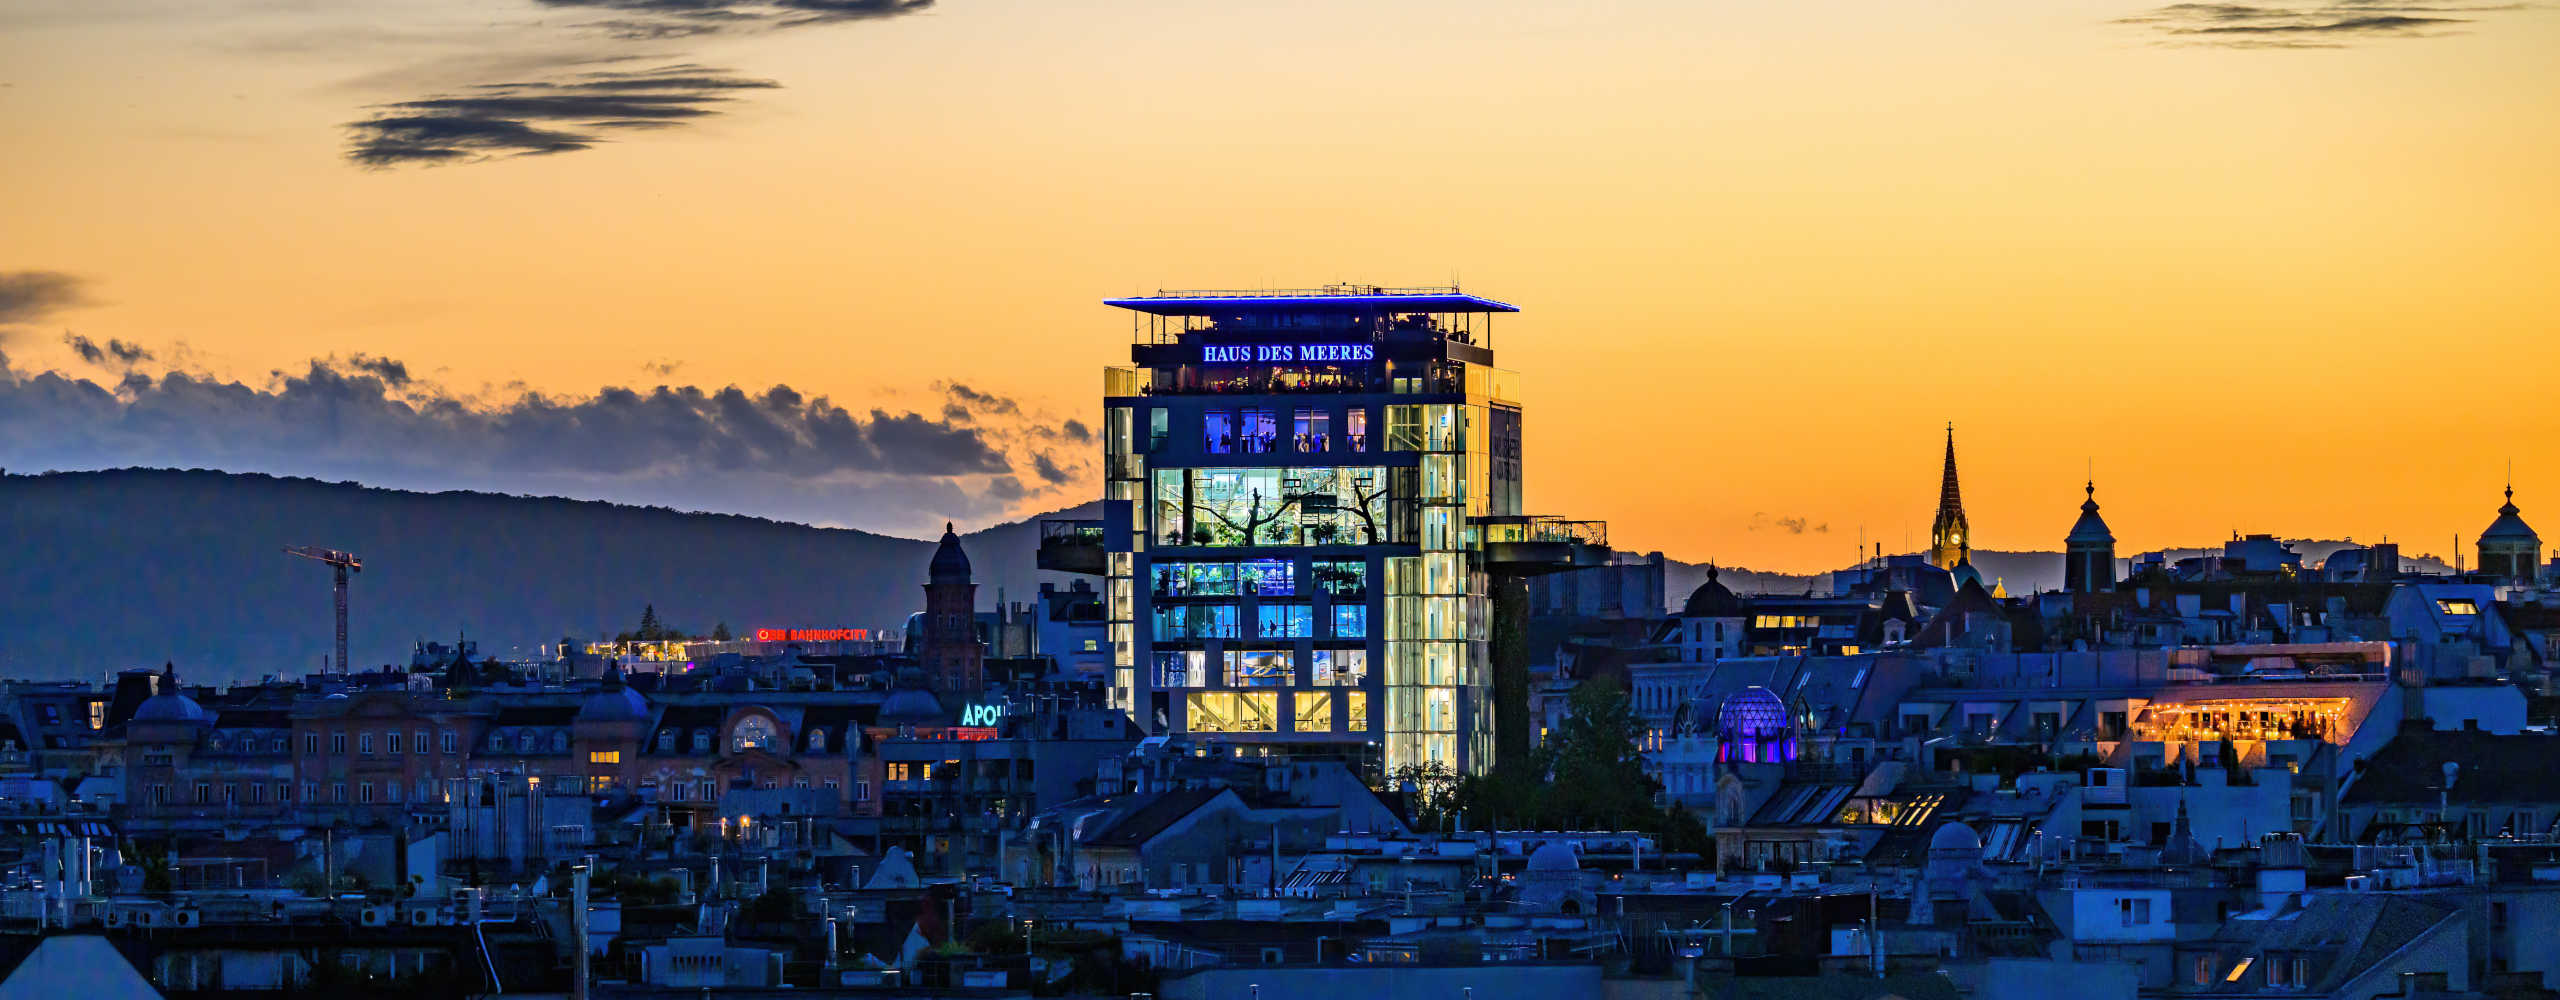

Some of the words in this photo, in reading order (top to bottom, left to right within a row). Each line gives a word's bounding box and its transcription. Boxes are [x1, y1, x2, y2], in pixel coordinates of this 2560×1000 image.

[1203, 346, 1251, 362] HAUS
[1258, 345, 1294, 361] DES
[1301, 344, 1375, 361] MEERES
[790, 629, 868, 641] BAHNHOFCITY
